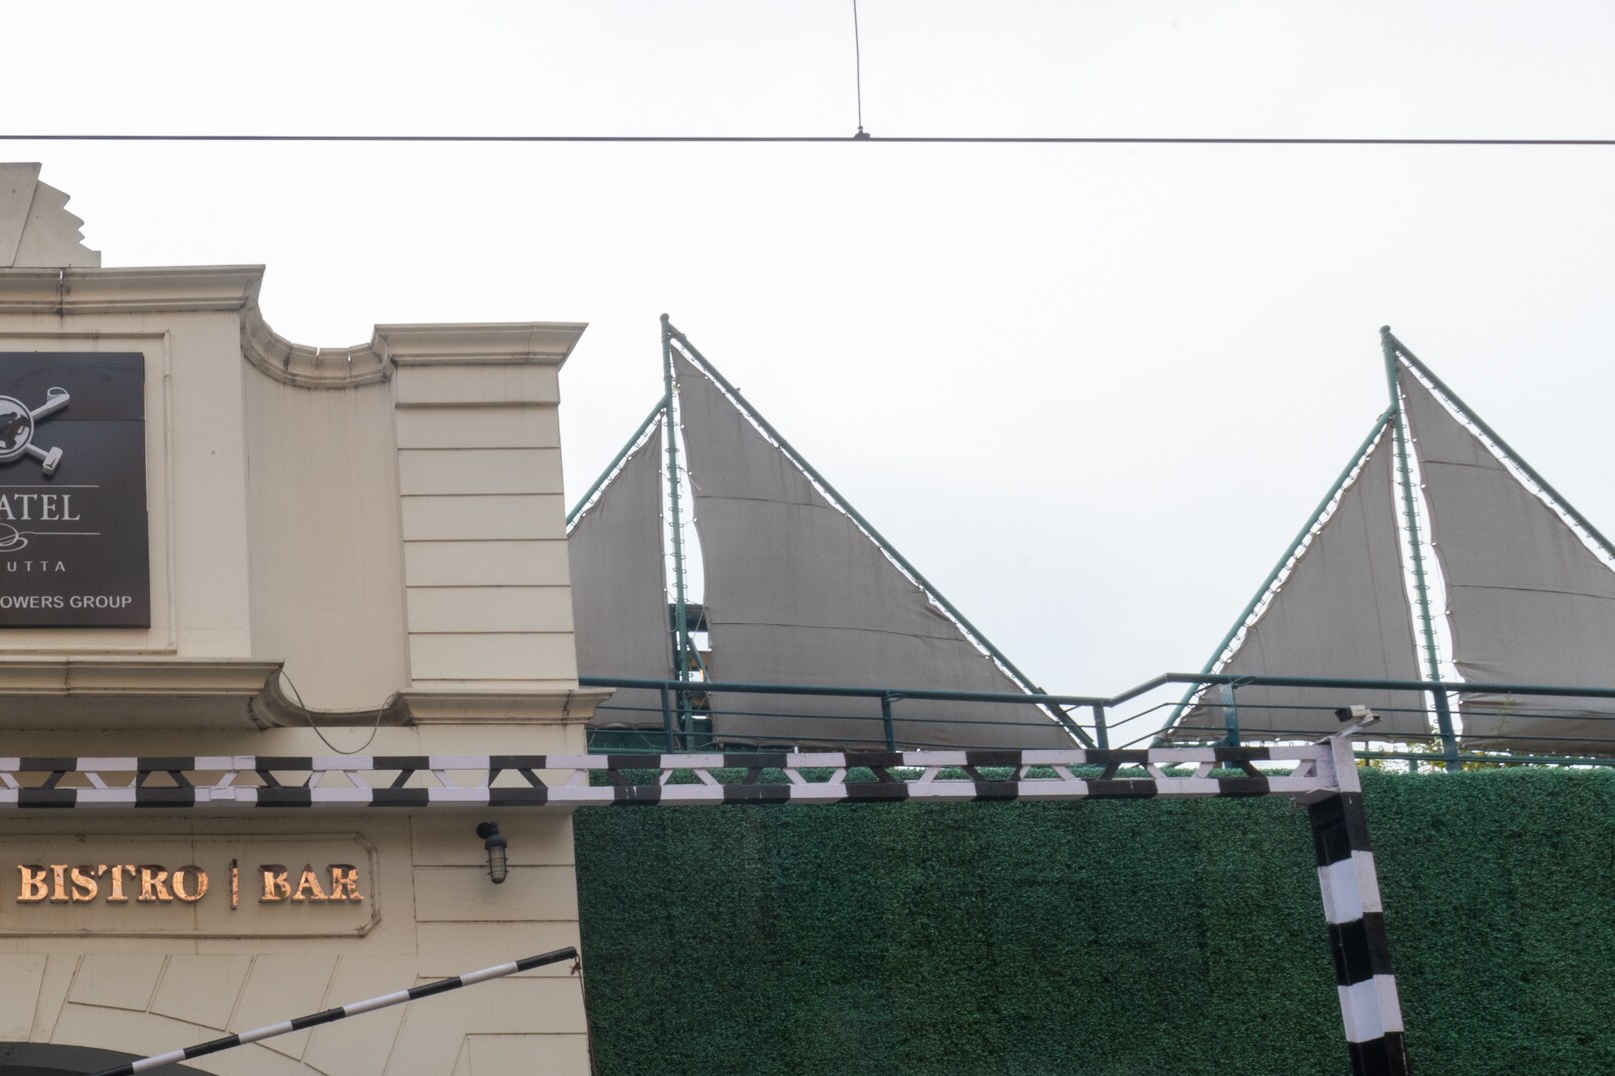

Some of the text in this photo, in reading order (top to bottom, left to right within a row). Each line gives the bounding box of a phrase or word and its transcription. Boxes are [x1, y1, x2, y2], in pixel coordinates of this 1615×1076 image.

[70, 595, 132, 609] GROUP
[16, 863, 210, 905] BISTRO
[258, 863, 365, 905] BAR
